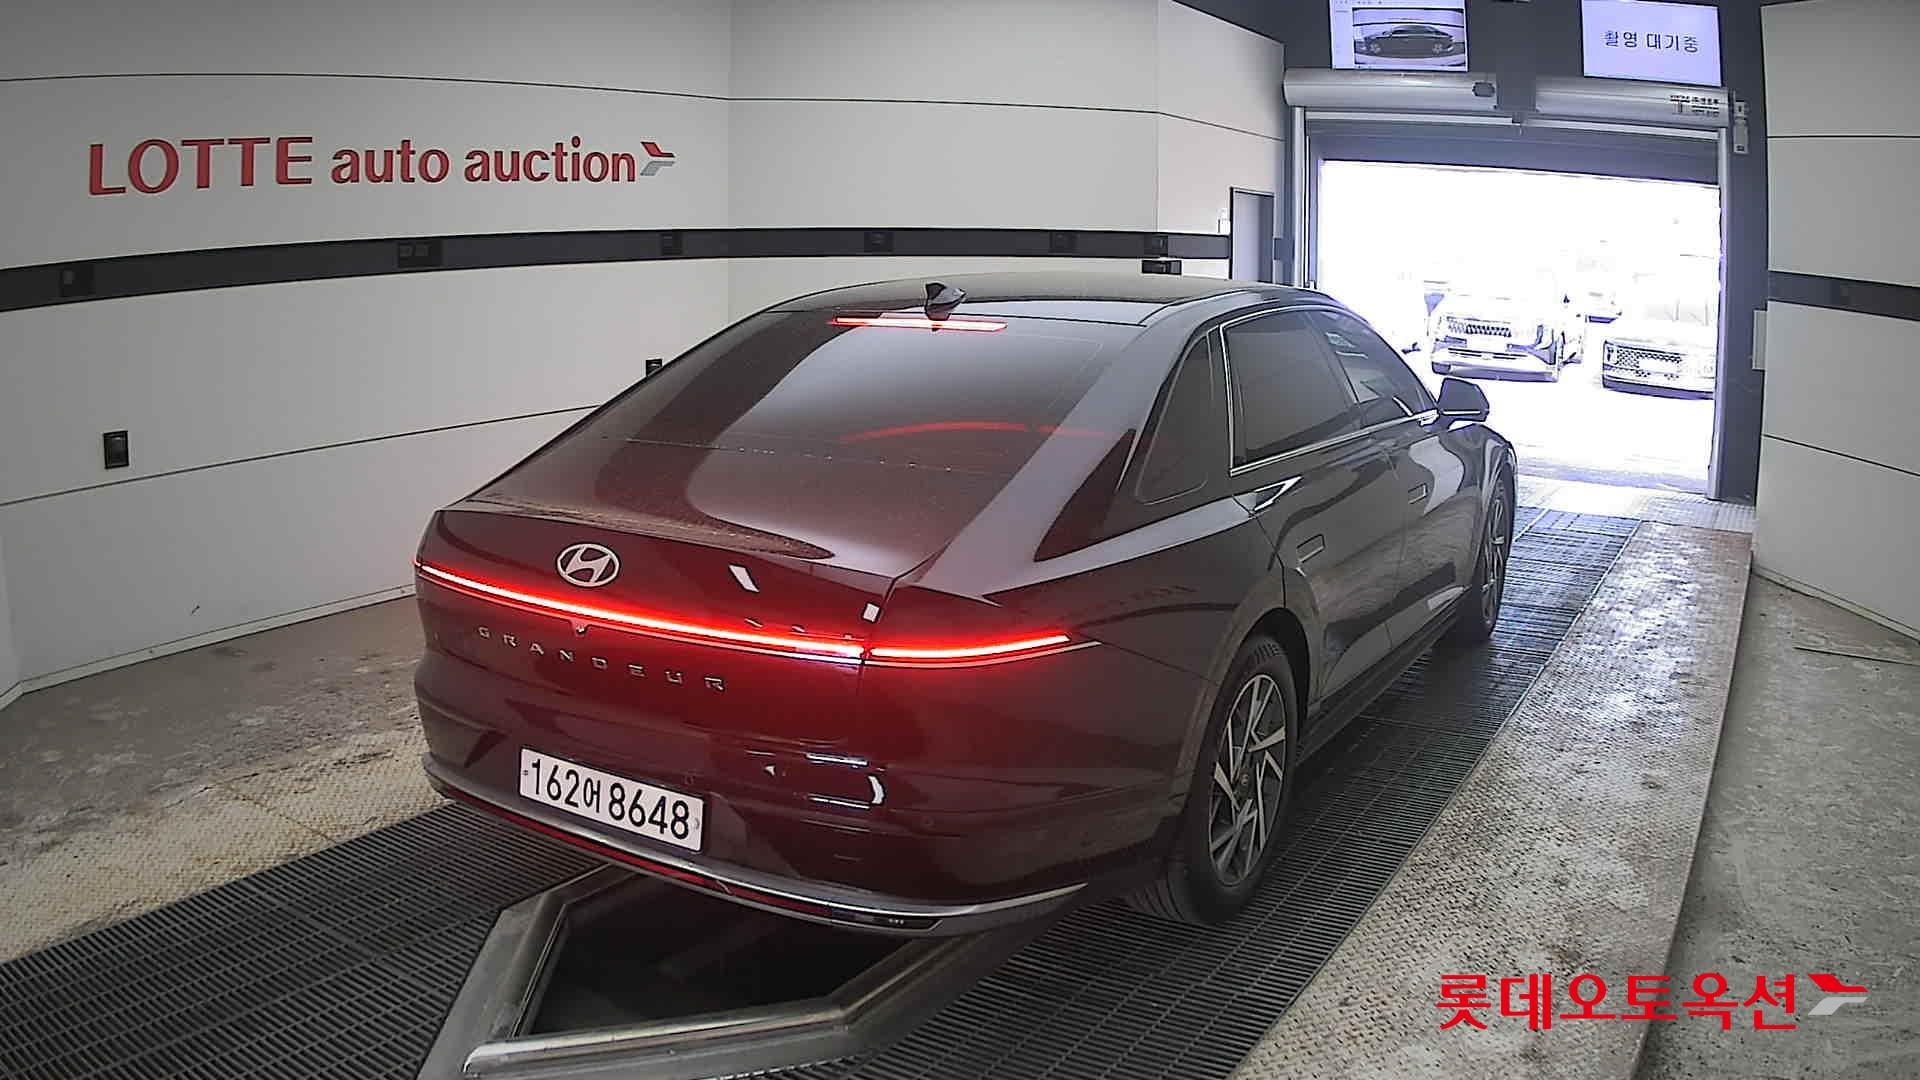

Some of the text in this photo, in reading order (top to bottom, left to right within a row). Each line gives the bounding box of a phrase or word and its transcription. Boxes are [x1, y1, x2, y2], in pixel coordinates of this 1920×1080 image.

[1604, 30, 1699, 53] 촬영 대기중
[89, 136, 636, 195] LOTTE auto auction
[478, 626, 726, 691] GRANDEUR
[532, 758, 690, 840] 162어 8648
